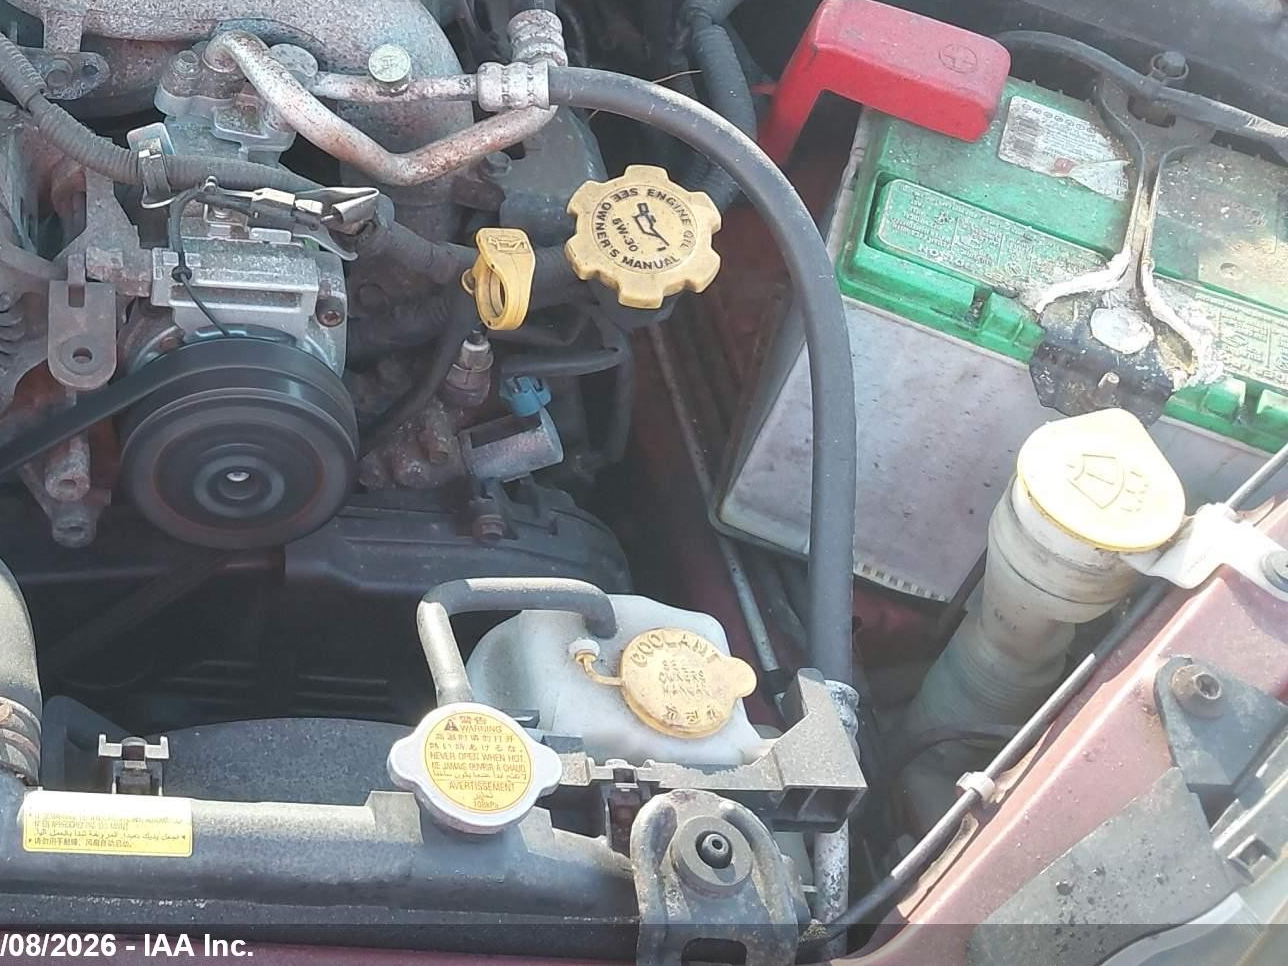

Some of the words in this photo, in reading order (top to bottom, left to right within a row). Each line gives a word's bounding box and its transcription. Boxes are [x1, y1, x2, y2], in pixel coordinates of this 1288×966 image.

[611, 187, 639, 203] SEE
[647, 188, 692, 226] ENGINE
[679, 230, 695, 250] OIL
[595, 202, 621, 258] OWNER'S
[621, 255, 681, 270] MANUAL
[630, 633, 722, 667] COOLANT
[460, 725, 502, 734] WARNING
[430, 752, 456, 761] NEVER
[458, 752, 479, 761] OPEN
[482, 753, 505, 762] WHEN
[449, 780, 515, 792] AVERTISSEMENT
